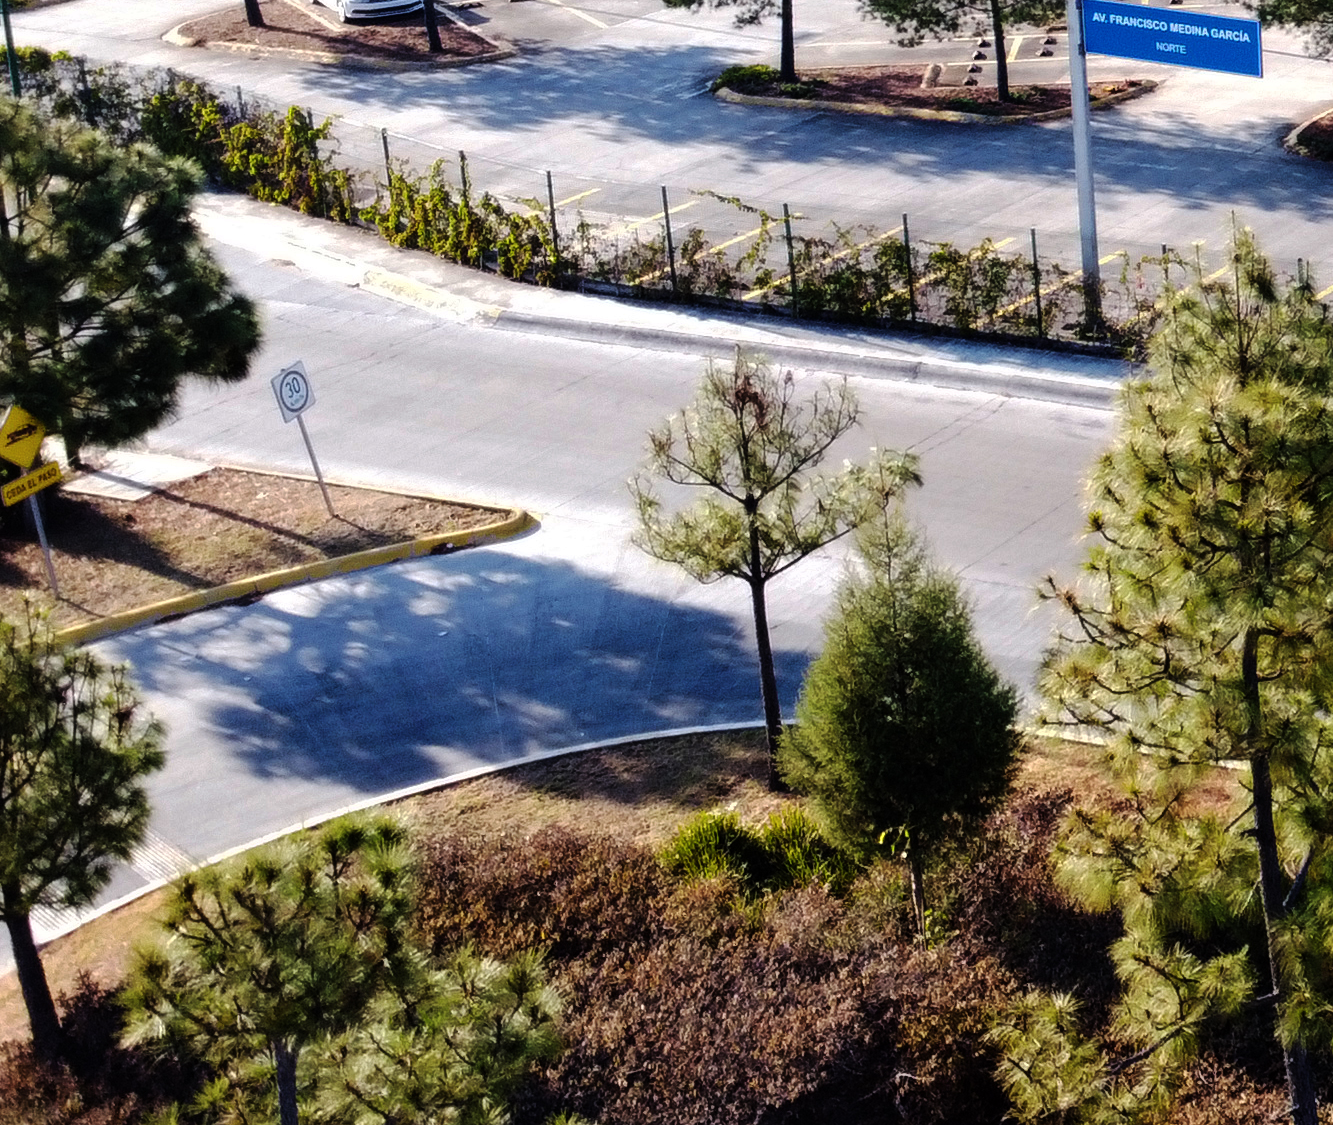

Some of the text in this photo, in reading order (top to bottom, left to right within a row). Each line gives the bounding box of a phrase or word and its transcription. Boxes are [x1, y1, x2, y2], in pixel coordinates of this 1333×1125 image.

[1092, 11, 1251, 43] AV. FRANCISCO MEDINA GARCÍA
[1155, 41, 1187, 55] NORTE
[285, 377, 301, 399] 30
[6, 467, 57, 500] CEDA EL PASO
